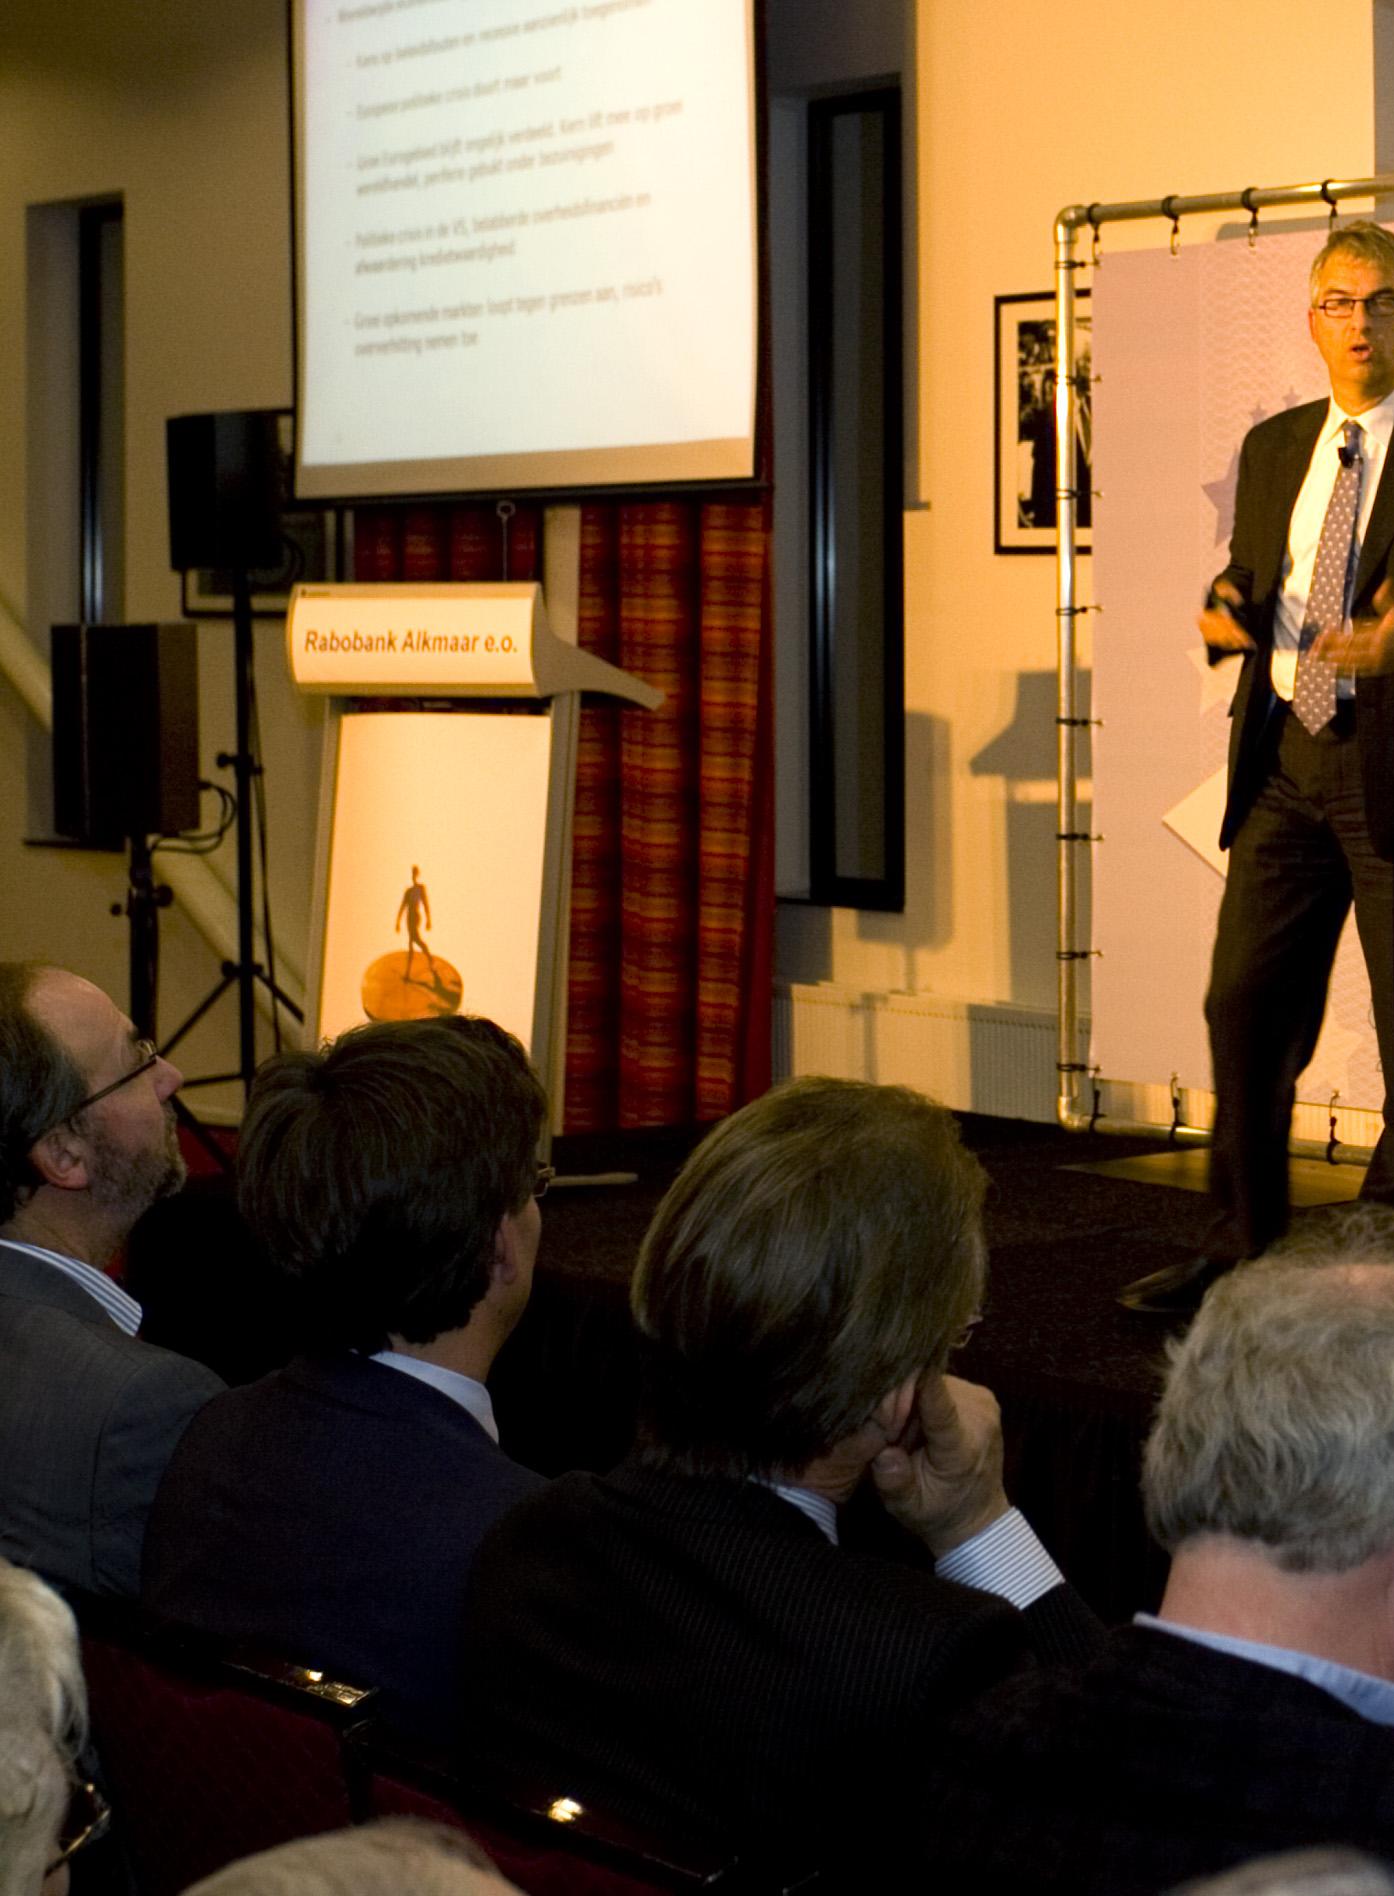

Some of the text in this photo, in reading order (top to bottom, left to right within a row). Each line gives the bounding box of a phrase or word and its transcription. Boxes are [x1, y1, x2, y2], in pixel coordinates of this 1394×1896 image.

[304, 630, 518, 654] Rabobank Alkmaar e.o.
